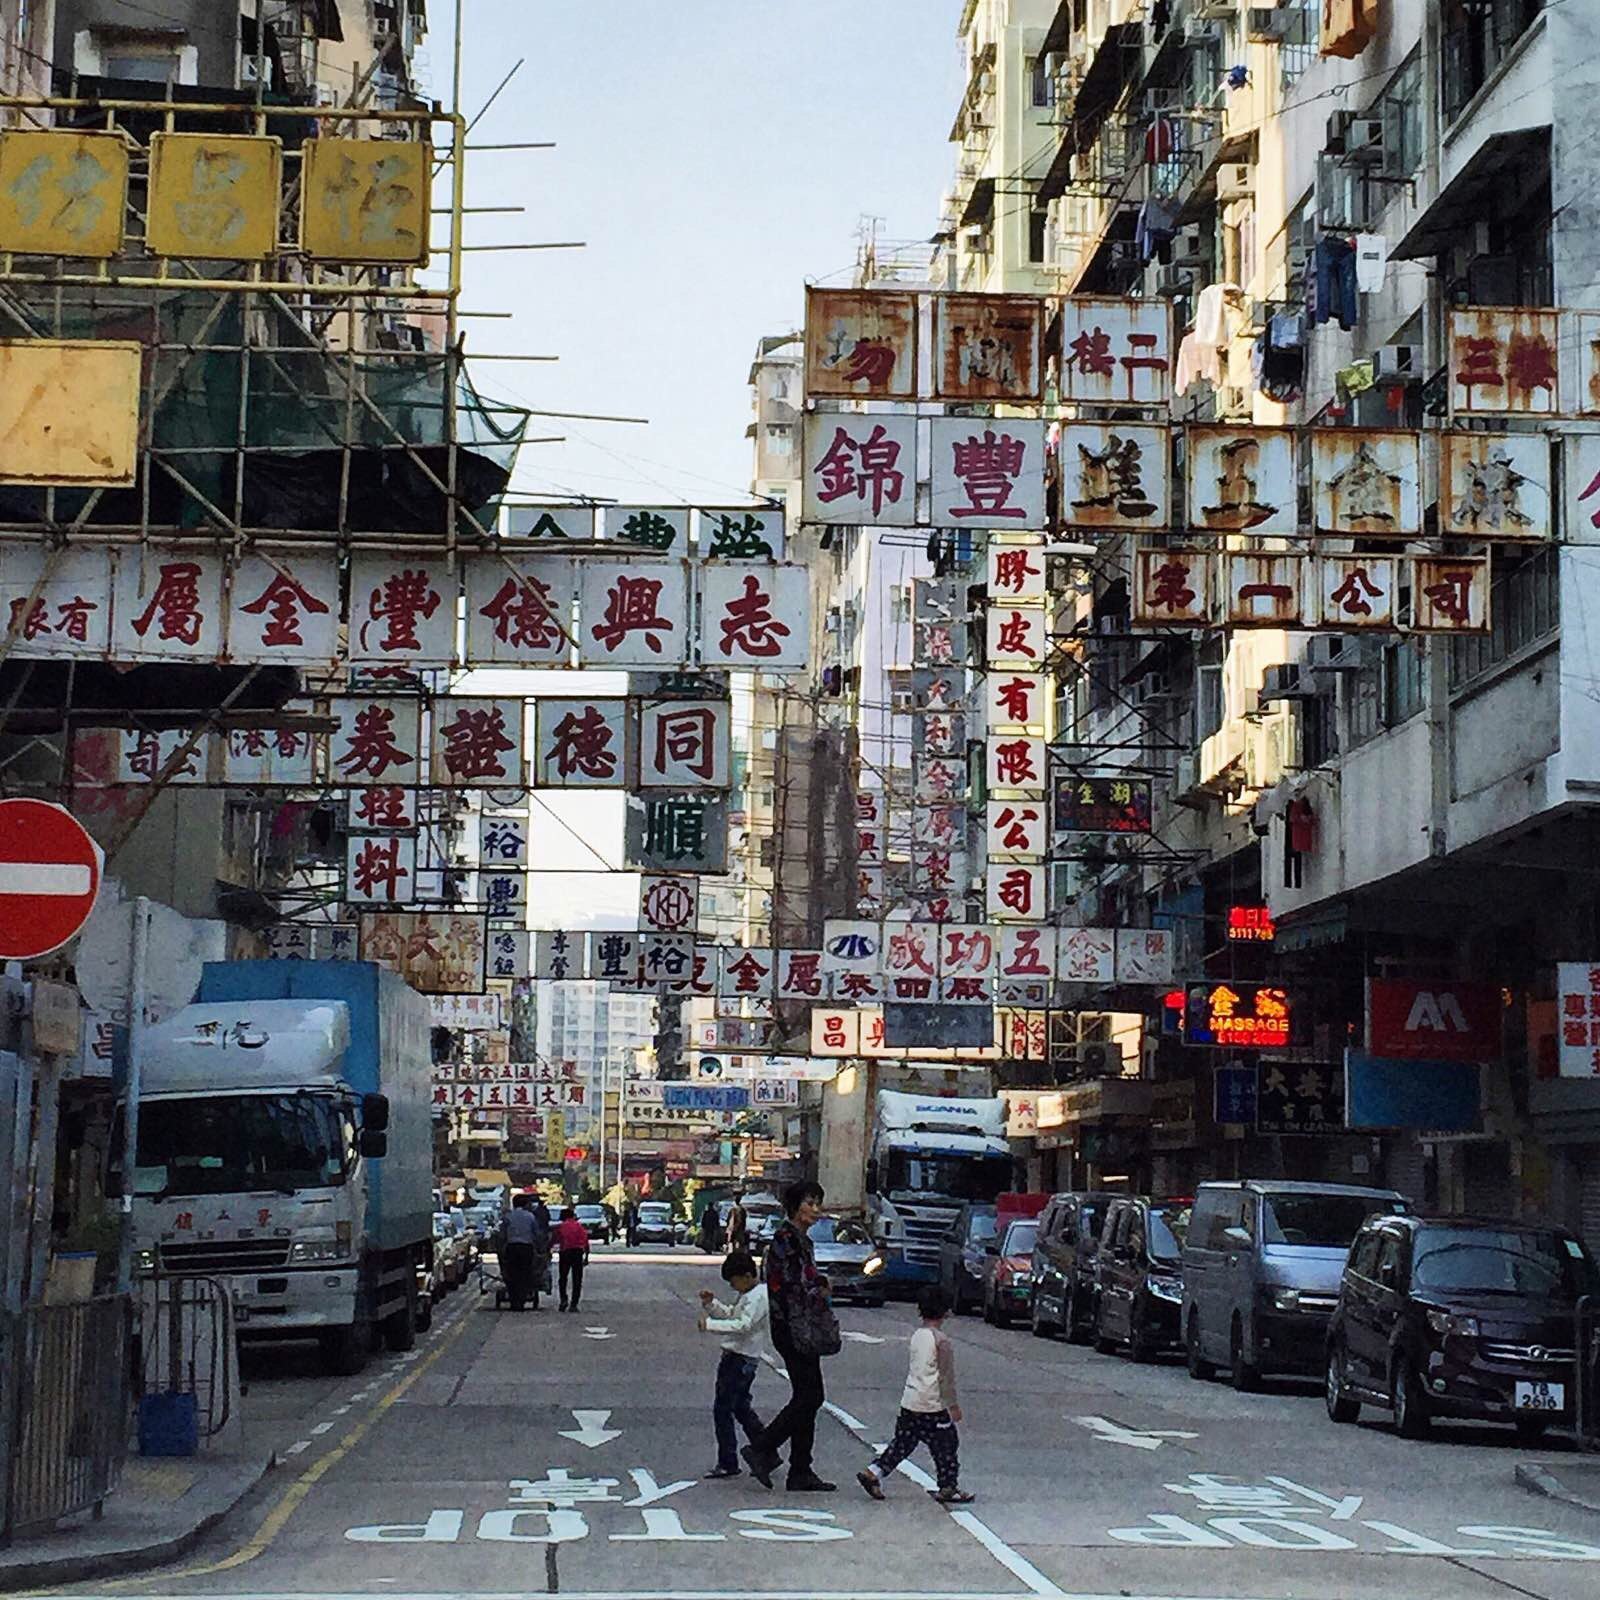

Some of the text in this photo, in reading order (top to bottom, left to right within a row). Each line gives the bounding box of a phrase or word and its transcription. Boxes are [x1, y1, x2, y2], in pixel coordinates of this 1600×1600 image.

[994, 549, 1040, 915] 膠皮有限公司
[1210, 1017, 1289, 1032] MASSAGE
[915, 1104, 978, 1116] SCANIA
[344, 1508, 854, 1543] STOP
